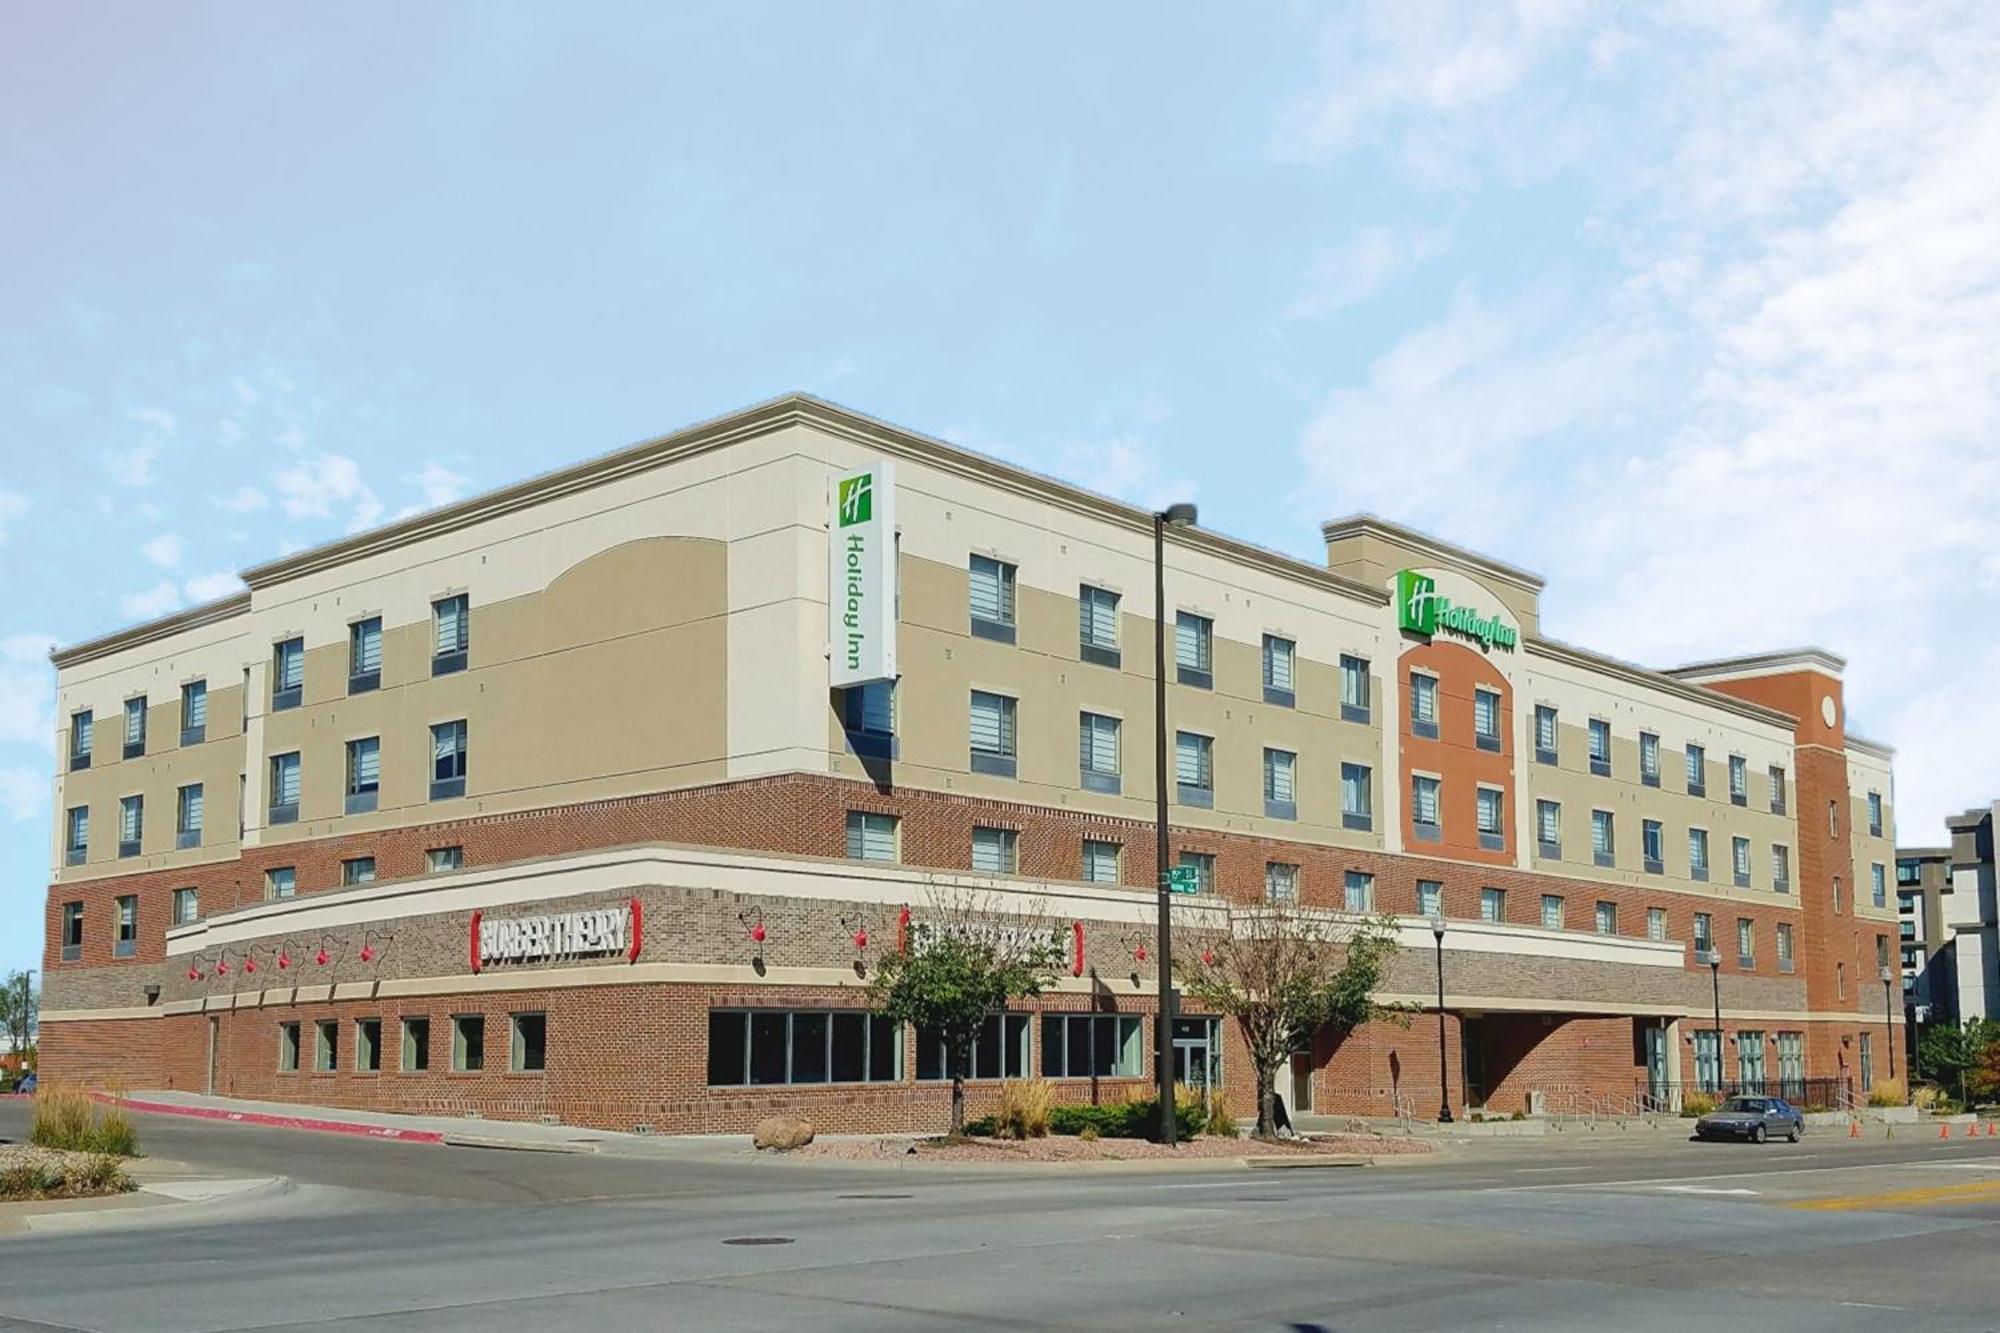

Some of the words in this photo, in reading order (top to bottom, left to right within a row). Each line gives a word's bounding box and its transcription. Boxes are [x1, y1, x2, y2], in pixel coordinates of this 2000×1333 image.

[843, 533, 864, 632] Holiday
[1434, 596, 1493, 645] Holiday
[1492, 615, 1517, 646] Inn
[848, 633, 864, 670] Inn
[480, 915, 550, 960] BURGER
[550, 908, 630, 955] THEORY
